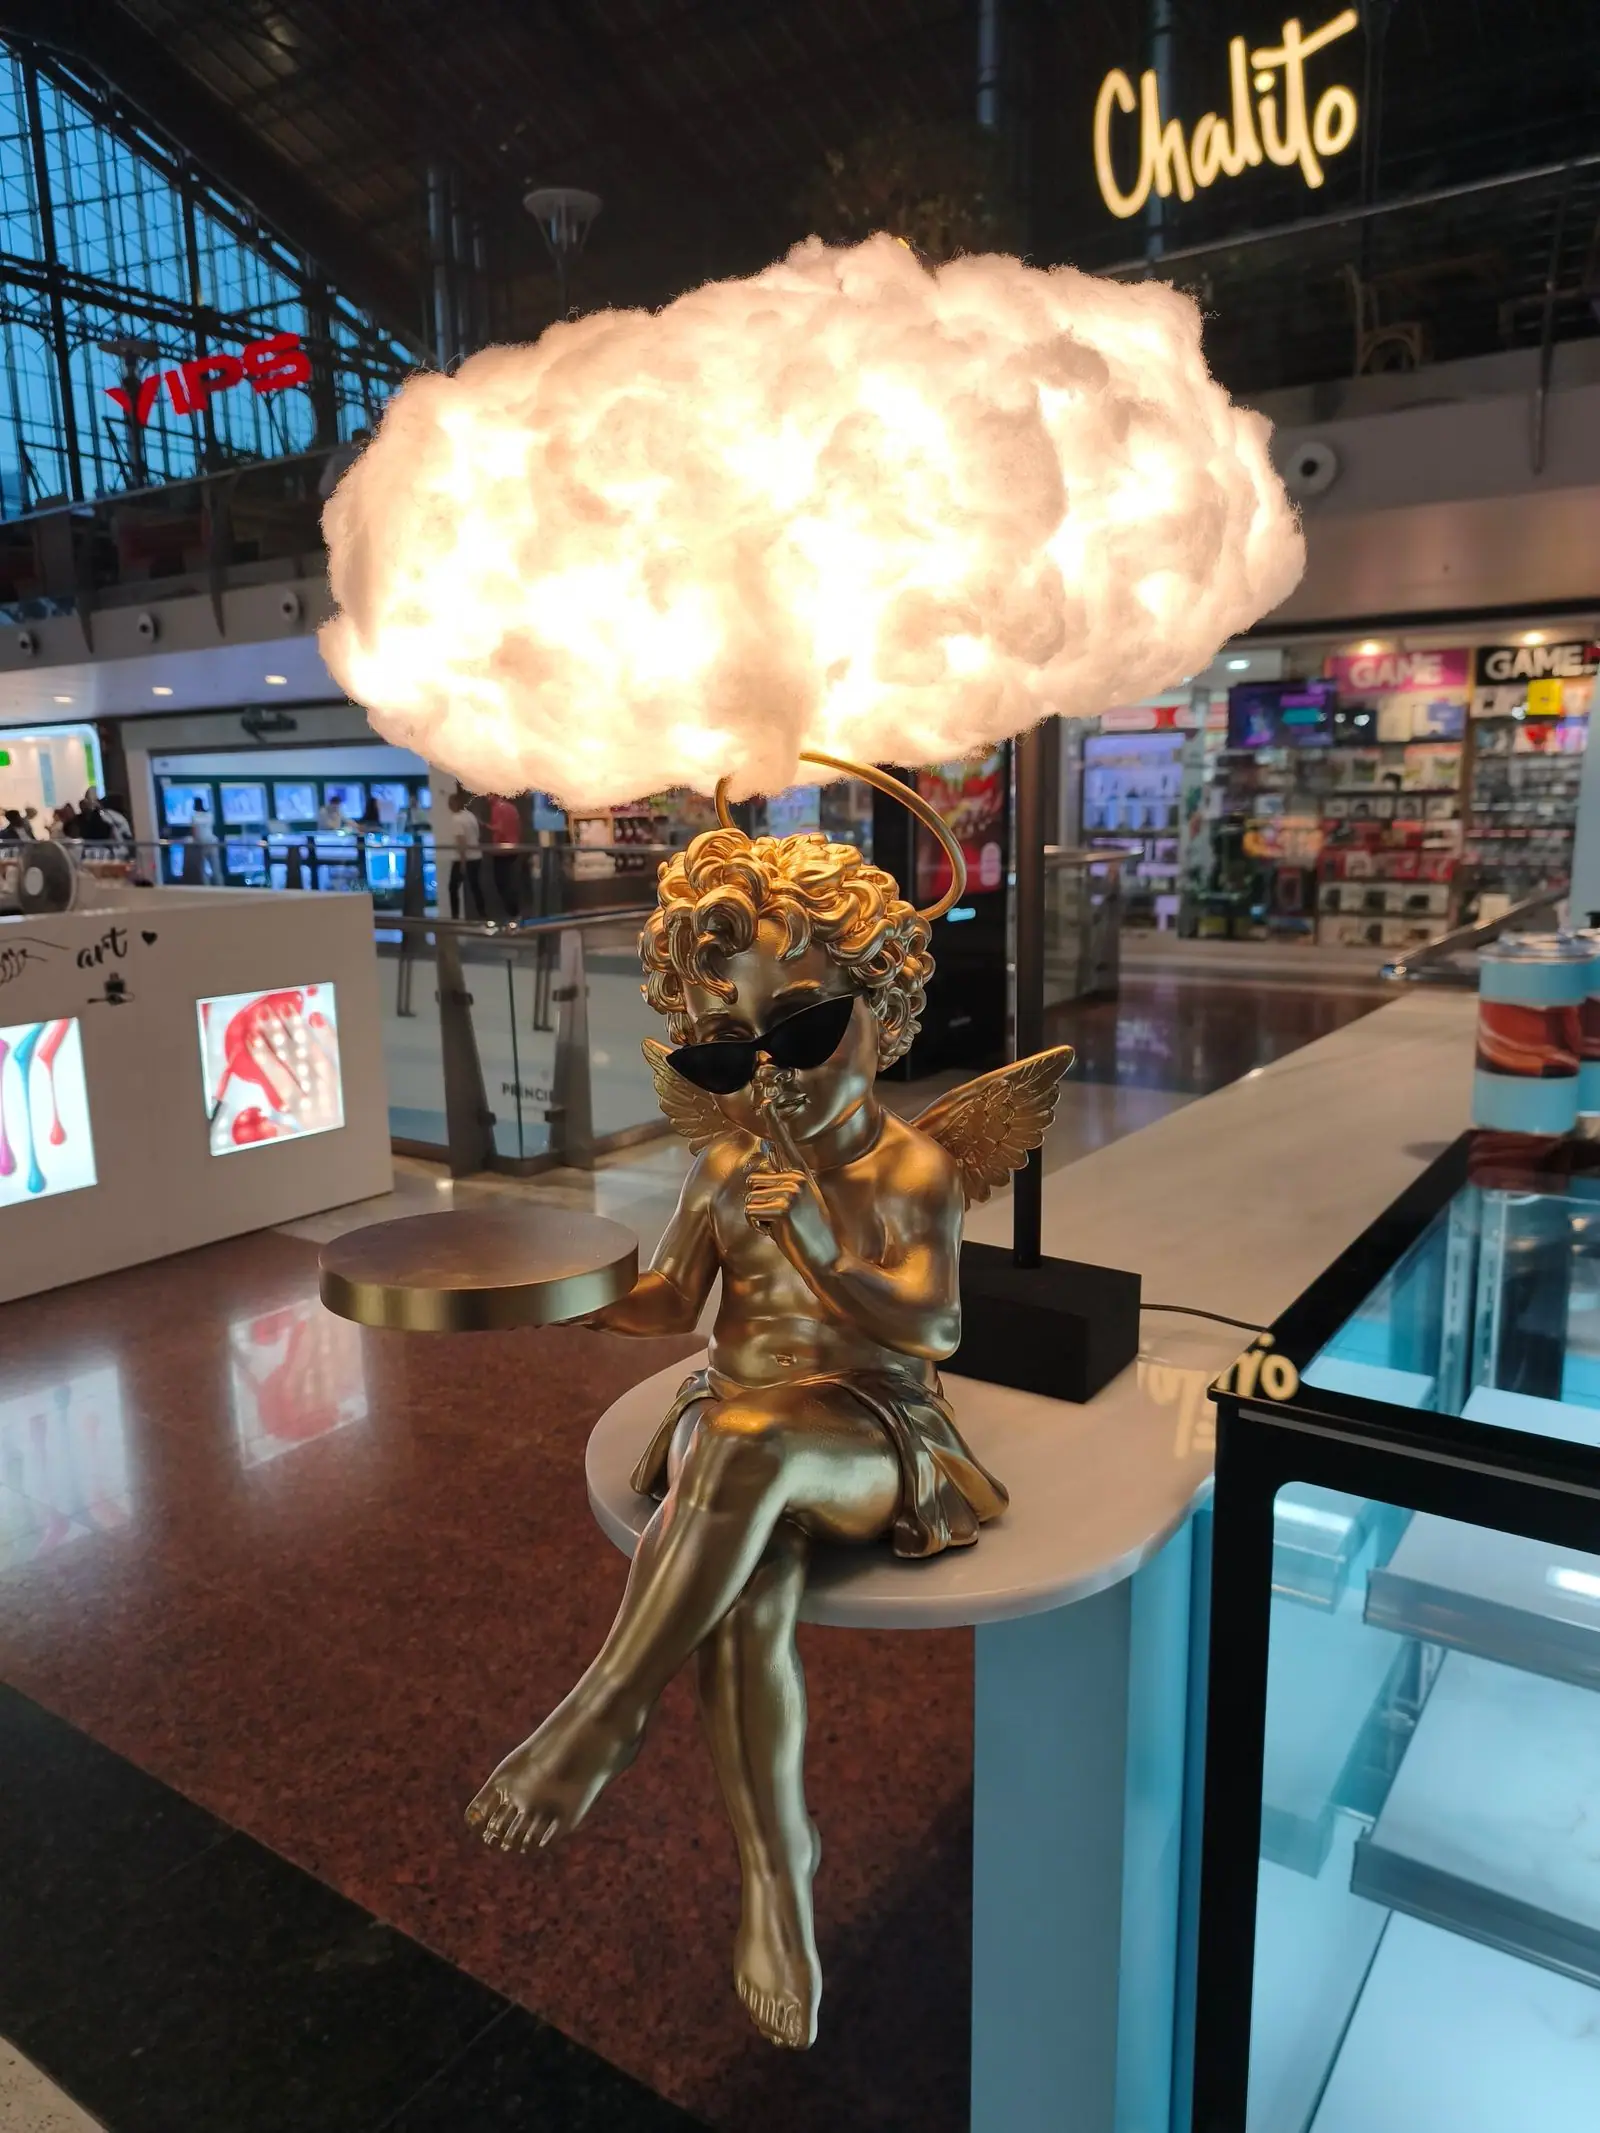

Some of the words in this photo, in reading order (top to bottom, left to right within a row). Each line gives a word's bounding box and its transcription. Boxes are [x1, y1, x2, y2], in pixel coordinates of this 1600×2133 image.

[1094, 8, 1358, 219] Chalito
[1350, 653, 1444, 687] GAME
[1486, 647, 1584, 680] GAME
[76, 926, 128, 969] art
